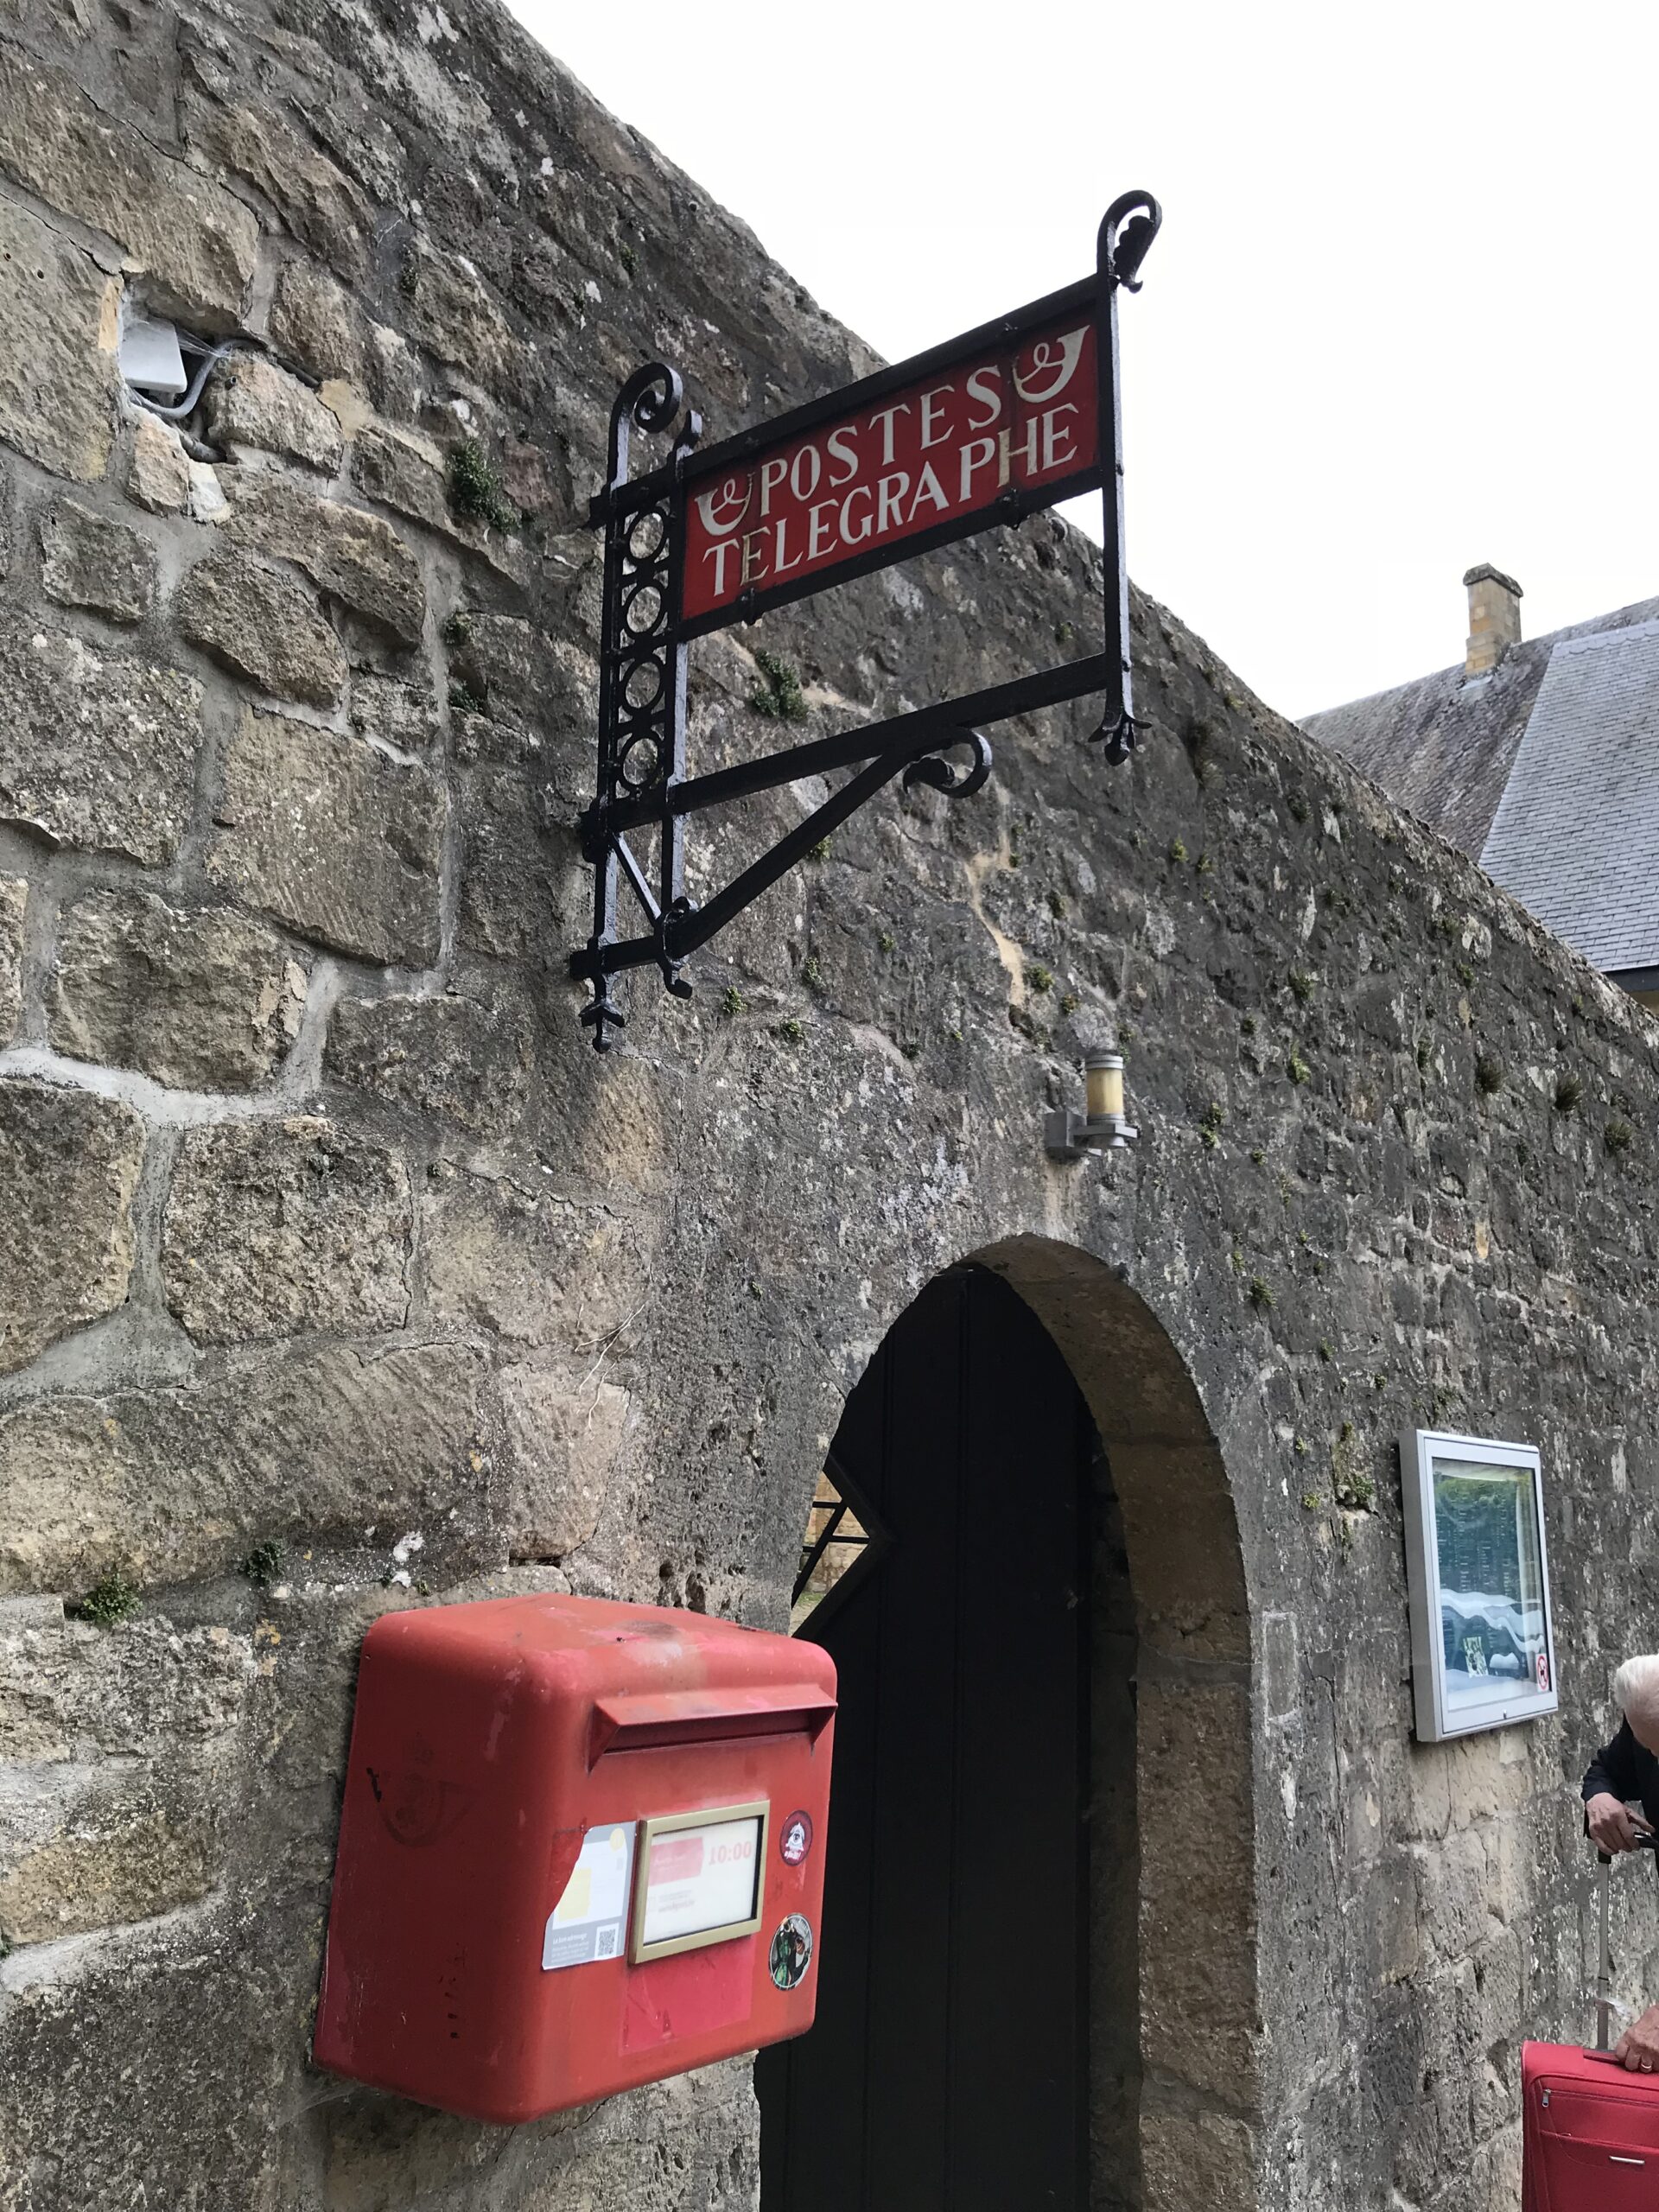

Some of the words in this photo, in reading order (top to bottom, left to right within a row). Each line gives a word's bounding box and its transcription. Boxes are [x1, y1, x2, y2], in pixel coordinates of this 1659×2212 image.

[702, 403, 1079, 597] TELEGRAPHE
[760, 365, 1001, 517] POSTES
[709, 1840, 752, 1866] 10:00
